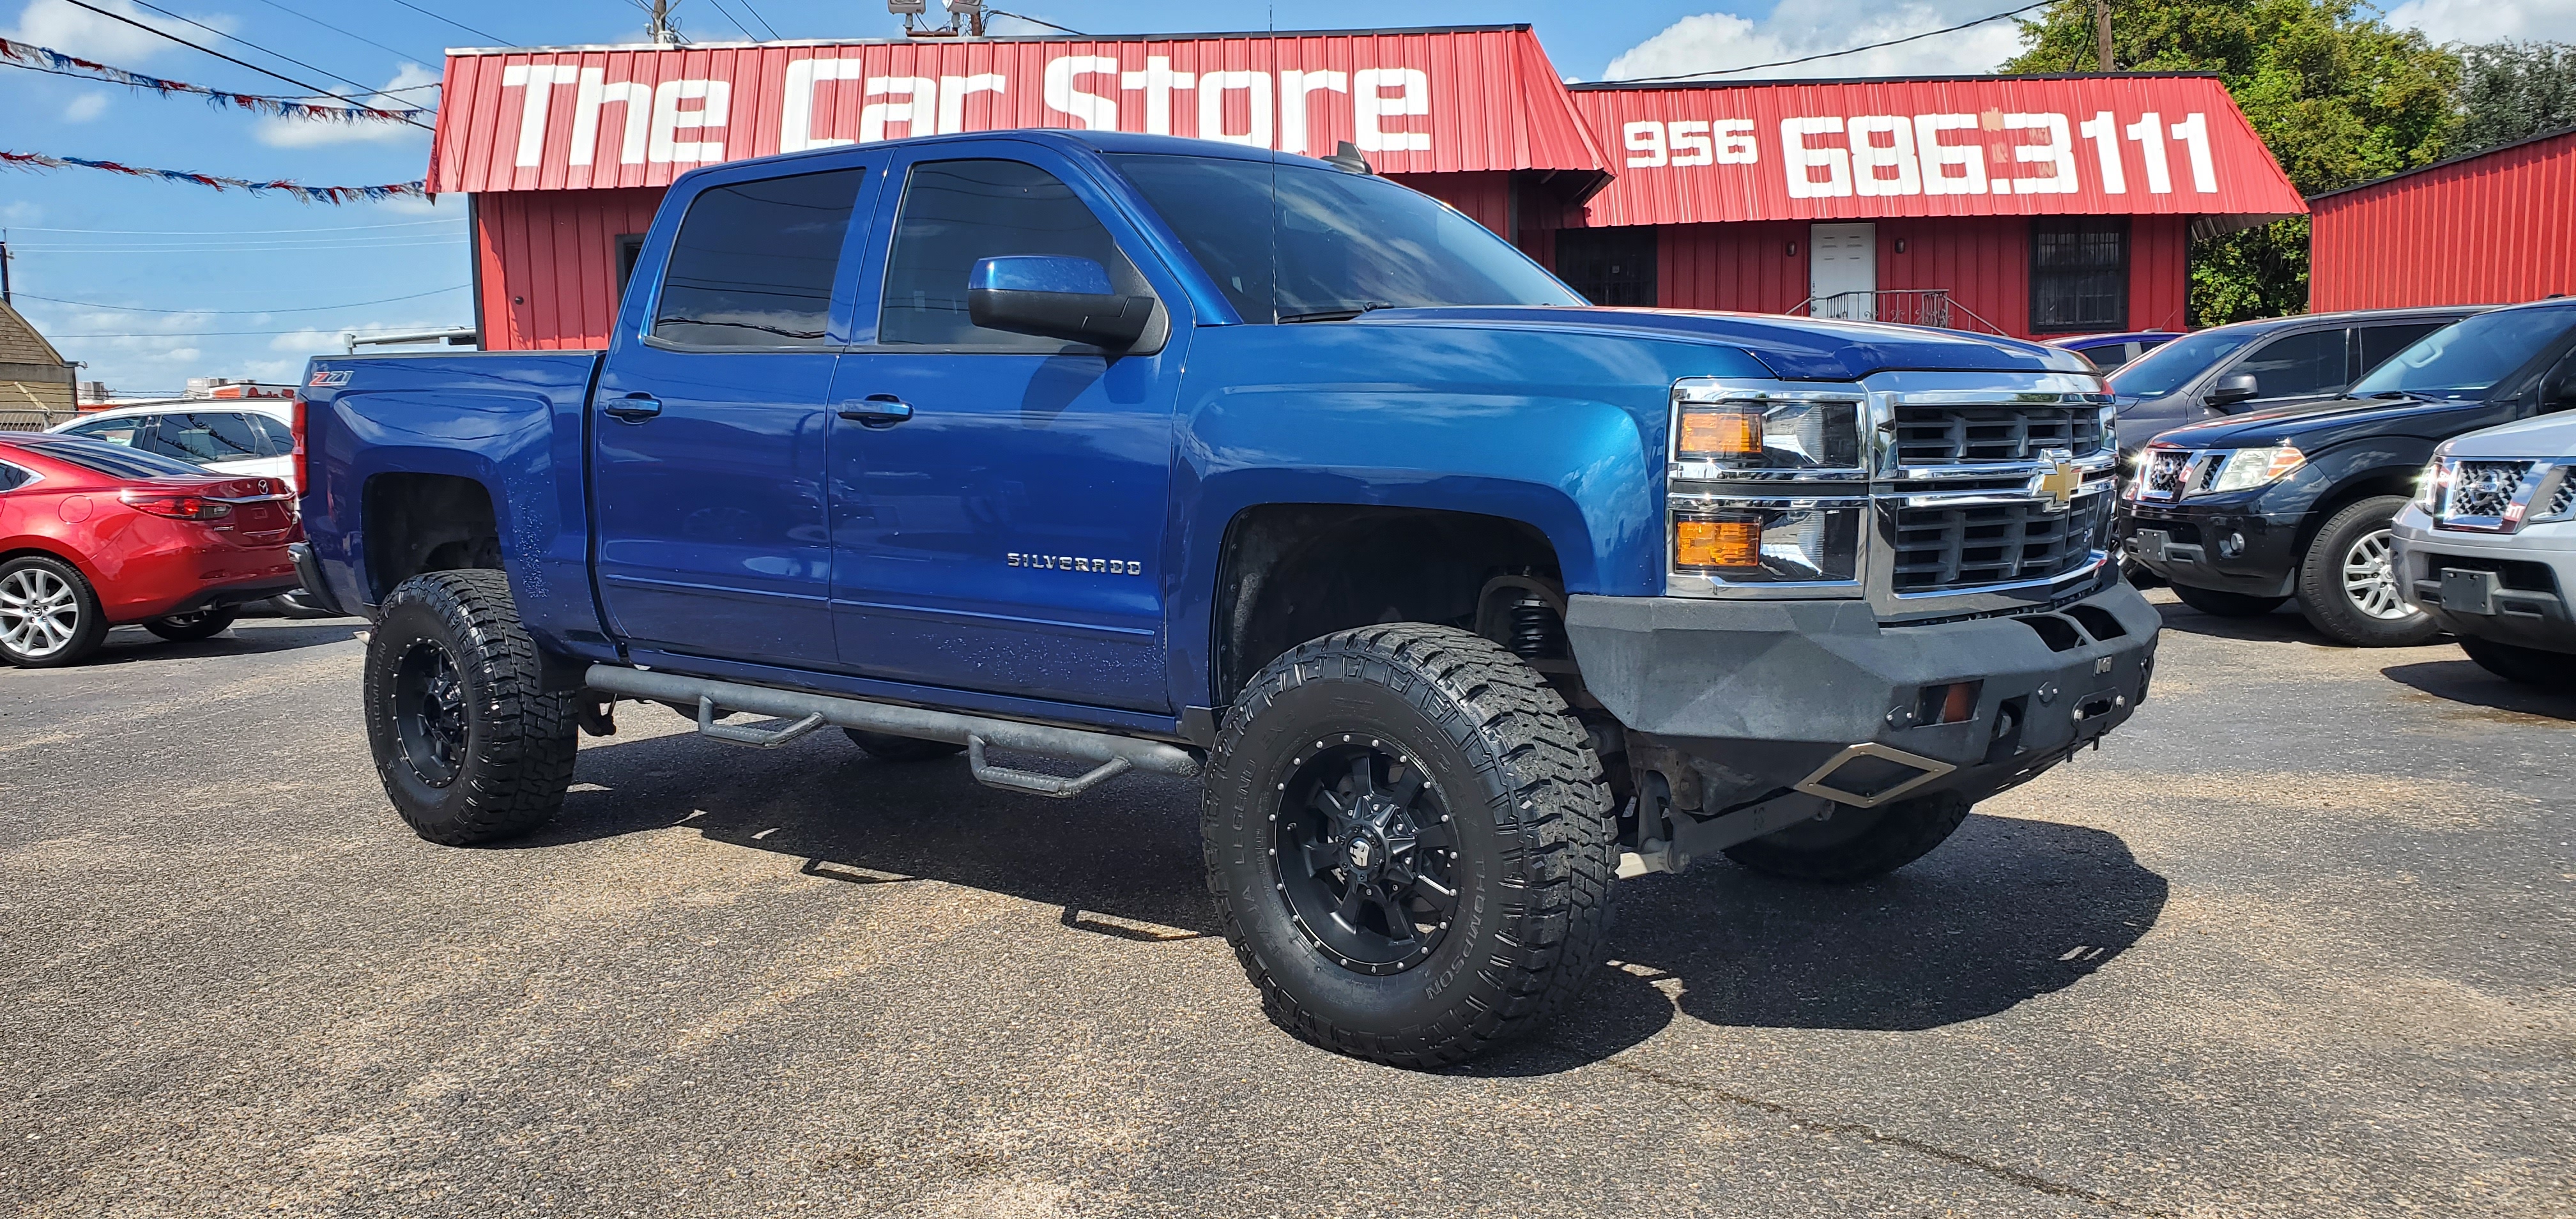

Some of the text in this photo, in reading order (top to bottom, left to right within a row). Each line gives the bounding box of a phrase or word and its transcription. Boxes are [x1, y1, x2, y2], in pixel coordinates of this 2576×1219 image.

[502, 54, 1430, 167] The Car Store
[1623, 118, 1758, 168] 956
[309, 371, 355, 387] Z71
[1007, 553, 1142, 575] SILVERADO
[1232, 758, 1256, 864] LEGEND
[1425, 854, 1485, 1001] THOMPSON
